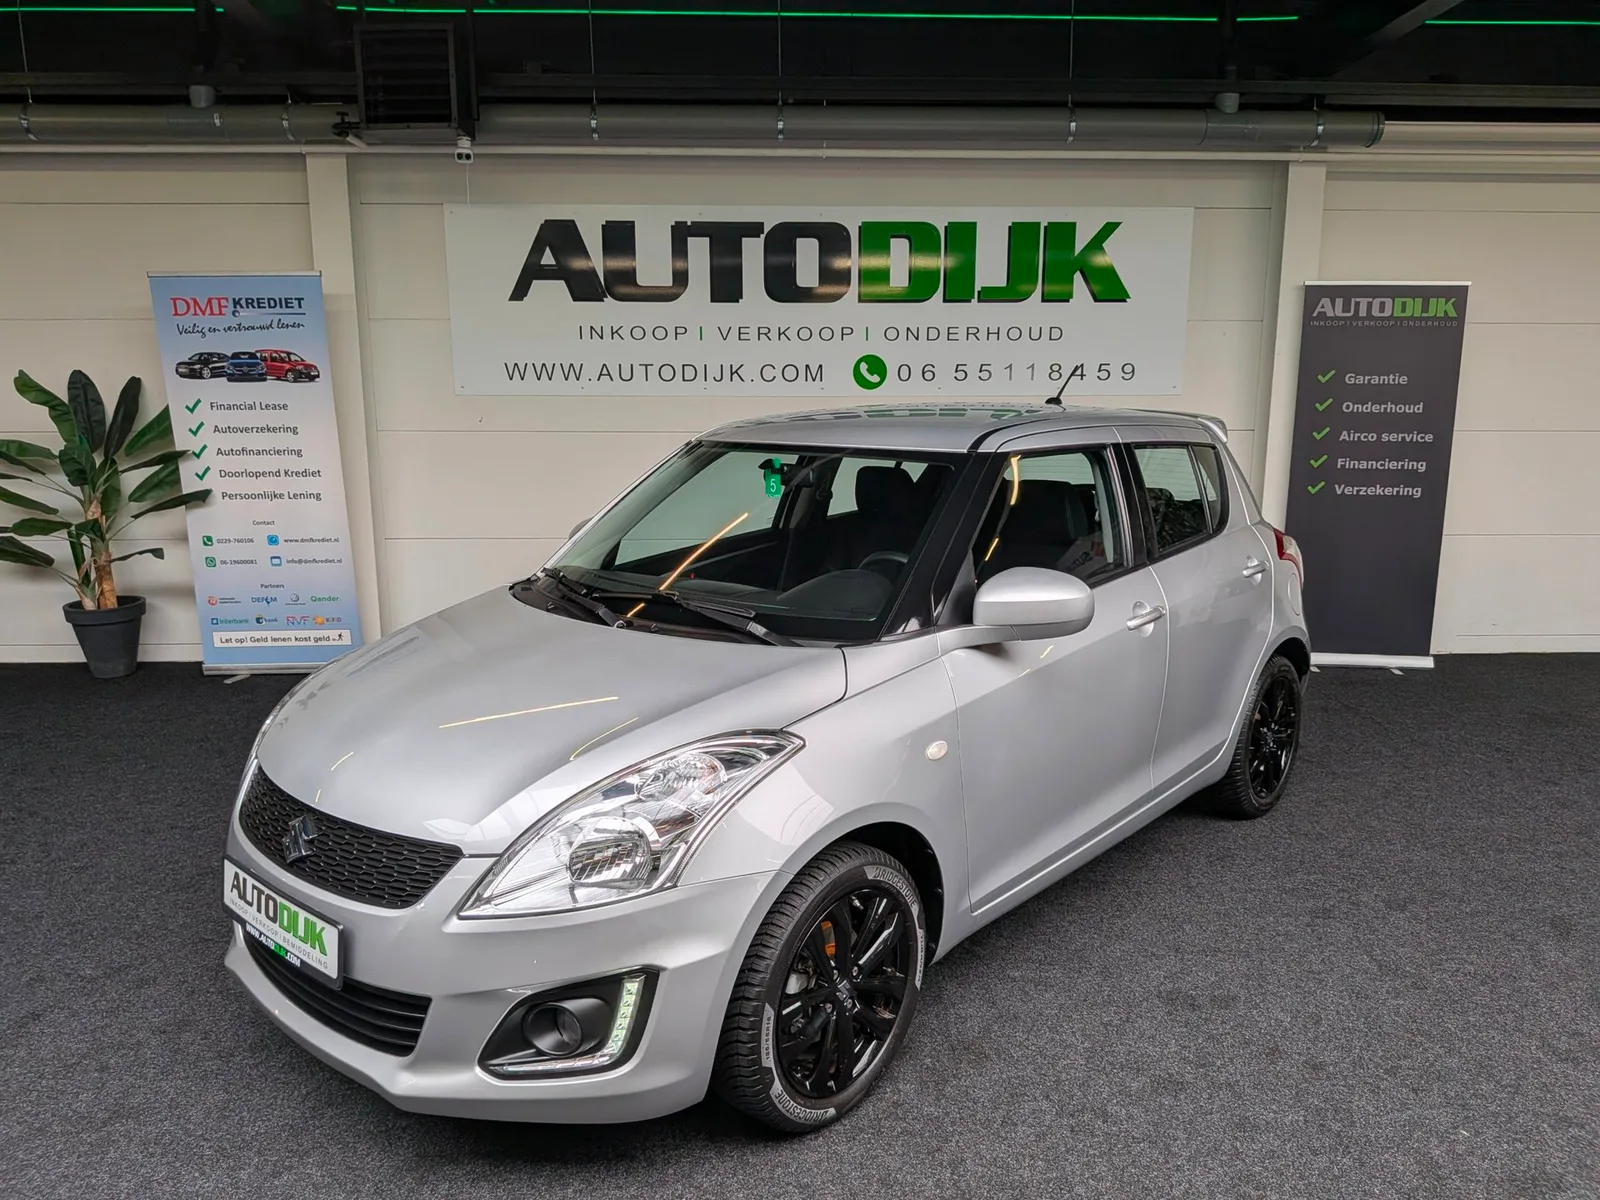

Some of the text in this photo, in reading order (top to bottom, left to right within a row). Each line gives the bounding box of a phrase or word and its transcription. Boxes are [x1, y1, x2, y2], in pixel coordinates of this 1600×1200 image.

[508, 218, 1132, 304] AUTODIJK
[169, 297, 305, 317] DMF KREDIET
[1311, 297, 1459, 318] AUTODIJK
[176, 318, 305, 339] Veilig en vertrouwd lenen
[1402, 320, 1459, 328] ONDERHOUD
[578, 325, 1065, 343] INKOOP VERKOOP ONDERHOUD
[503, 362, 824, 384] WWW.AUTODIJK.COM
[897, 363, 937, 383] 06
[1344, 373, 1409, 385] Garantie
[209, 401, 289, 411] Financial Lease
[1341, 401, 1424, 413] Onderhoud
[212, 424, 300, 436] Autoverzekering
[1338, 430, 1434, 443] Airco service
[216, 447, 304, 458] Autofinanciering
[1336, 458, 1427, 473] Financiering
[218, 468, 322, 480] Doorlopend Krediet
[770, 478, 777, 493] 5
[1334, 484, 1422, 499] Verzekering
[221, 491, 323, 502] Persoonlijke Lening
[283, 536, 340, 544] www.dmfkrediet.nl
[285, 557, 343, 565] info@dmfkrediet.nl
[219, 636, 233, 644] Let
[234, 636, 249, 645] op!
[249, 635, 269, 643] Geld
[270, 635, 292, 643] lenen
[294, 634, 312, 642] kost
[872, 867, 916, 909] BRIDGESTONE
[230, 870, 328, 957] AUTODIJK
[251, 915, 280, 937] VERKOOP
[774, 1089, 830, 1123] BRIDGESTONE
